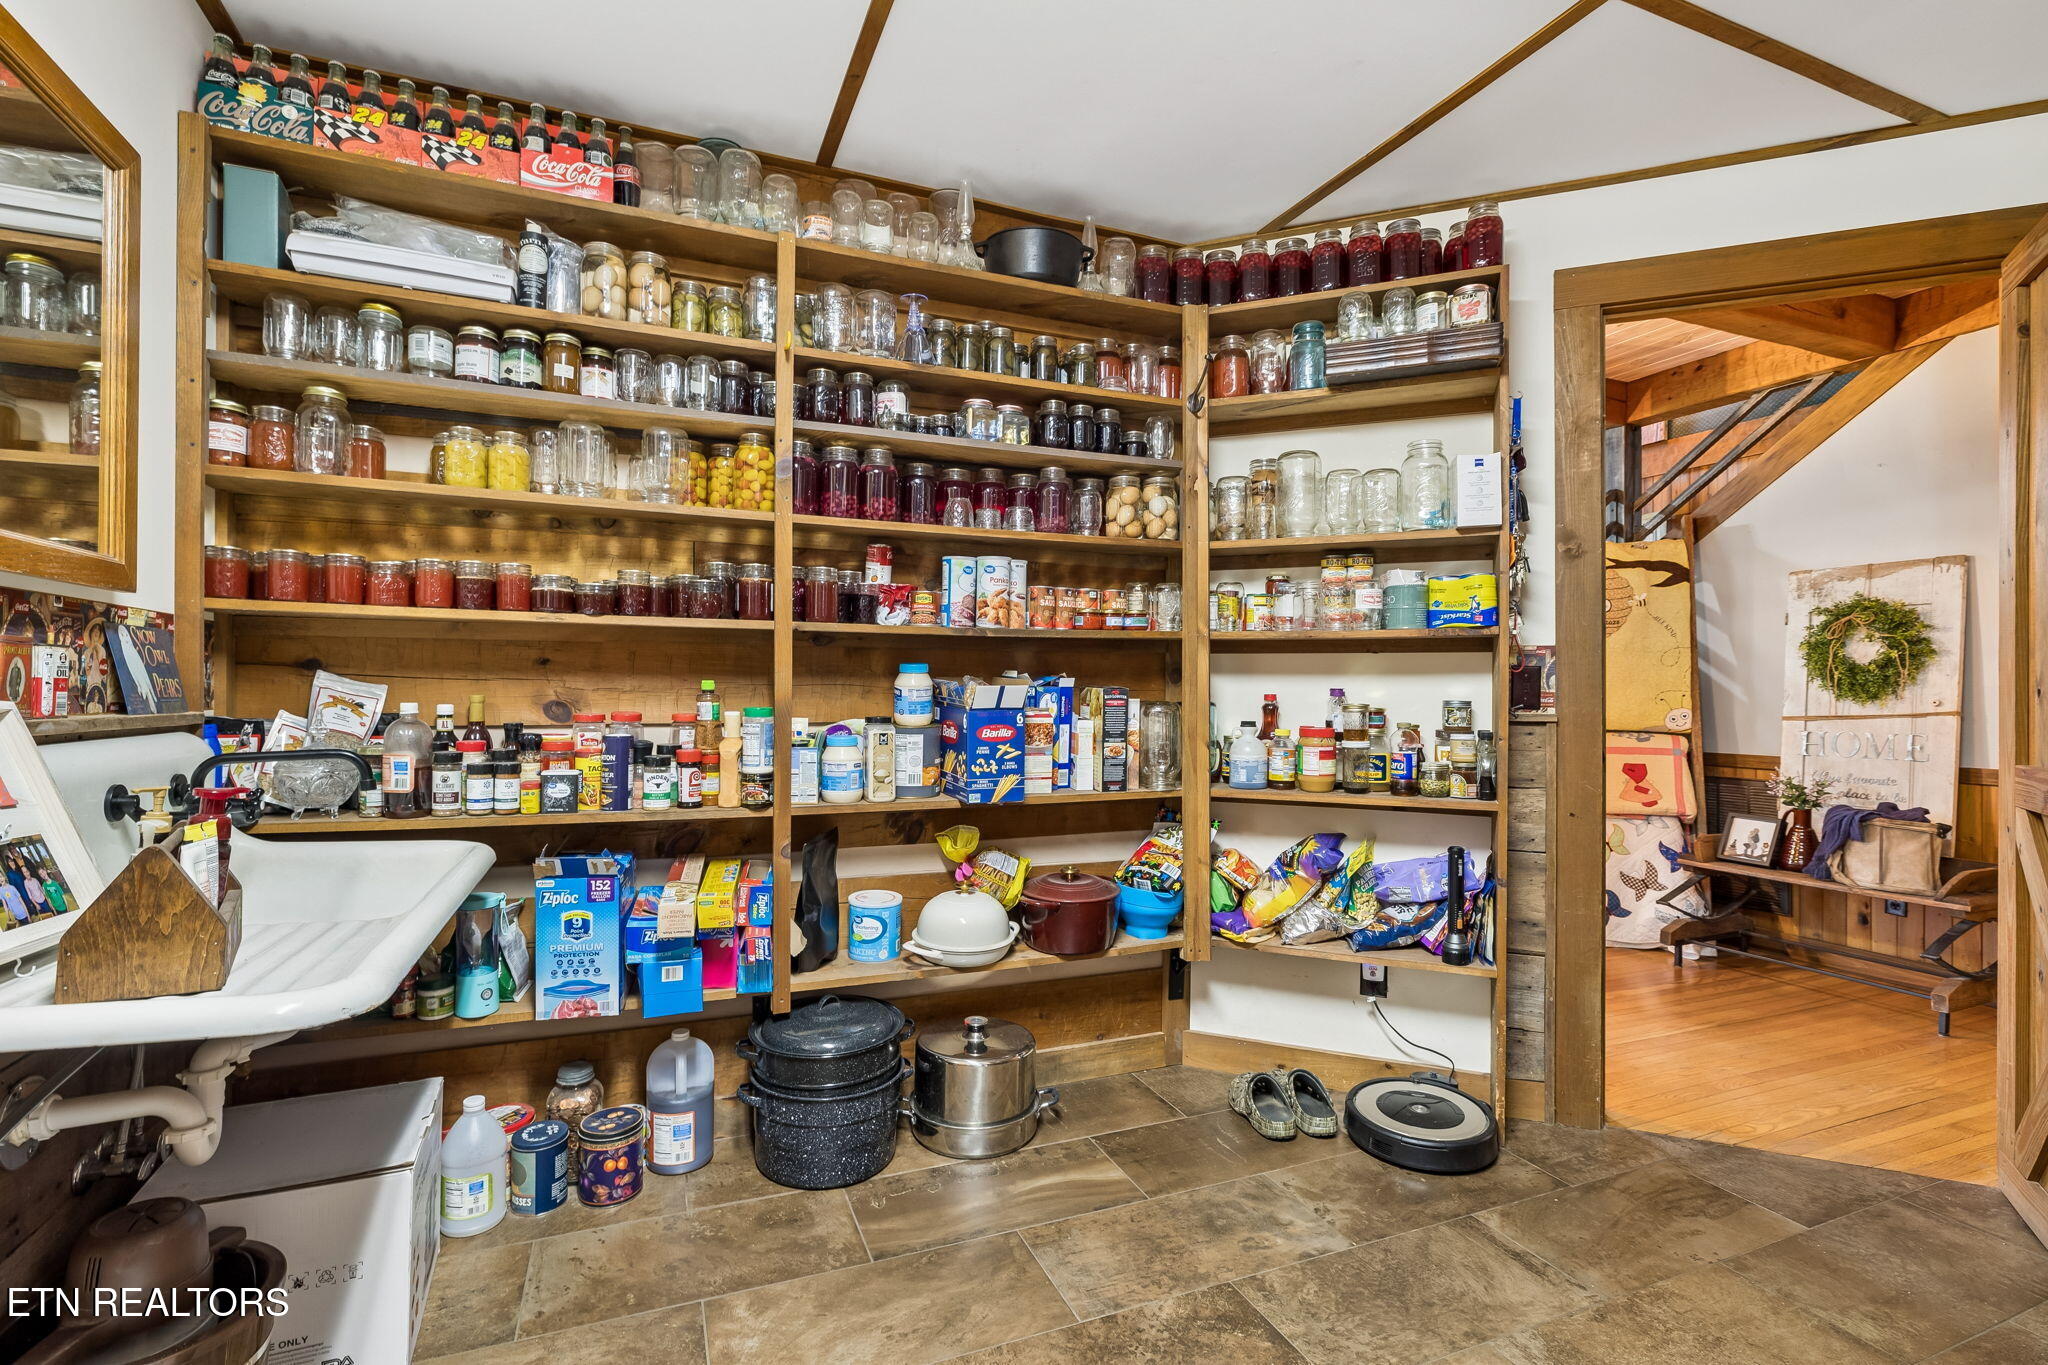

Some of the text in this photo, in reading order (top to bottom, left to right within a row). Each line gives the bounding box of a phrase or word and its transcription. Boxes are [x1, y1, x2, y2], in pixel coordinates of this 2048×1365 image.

[352, 106, 386, 128] 24
[456, 131, 487, 151] 24
[532, 154, 602, 187] Coca-Cola
[1440, 612, 1471, 620] StarKist
[152, 672, 182, 698] PEARS
[1016, 712, 1024, 724] 6
[942, 725, 957, 739] Barilla
[981, 728, 1014, 738] Barilla
[1797, 730, 1930, 763] HOME
[1390, 761, 1404, 770] aro
[590, 880, 611, 891] 152
[541, 891, 579, 907] Ziploc
[757, 894, 768, 919] Ziploc
[572, 917, 582, 928] 9
[549, 942, 605, 953] PREMIUM
[278, 1335, 309, 1350] ONLY
